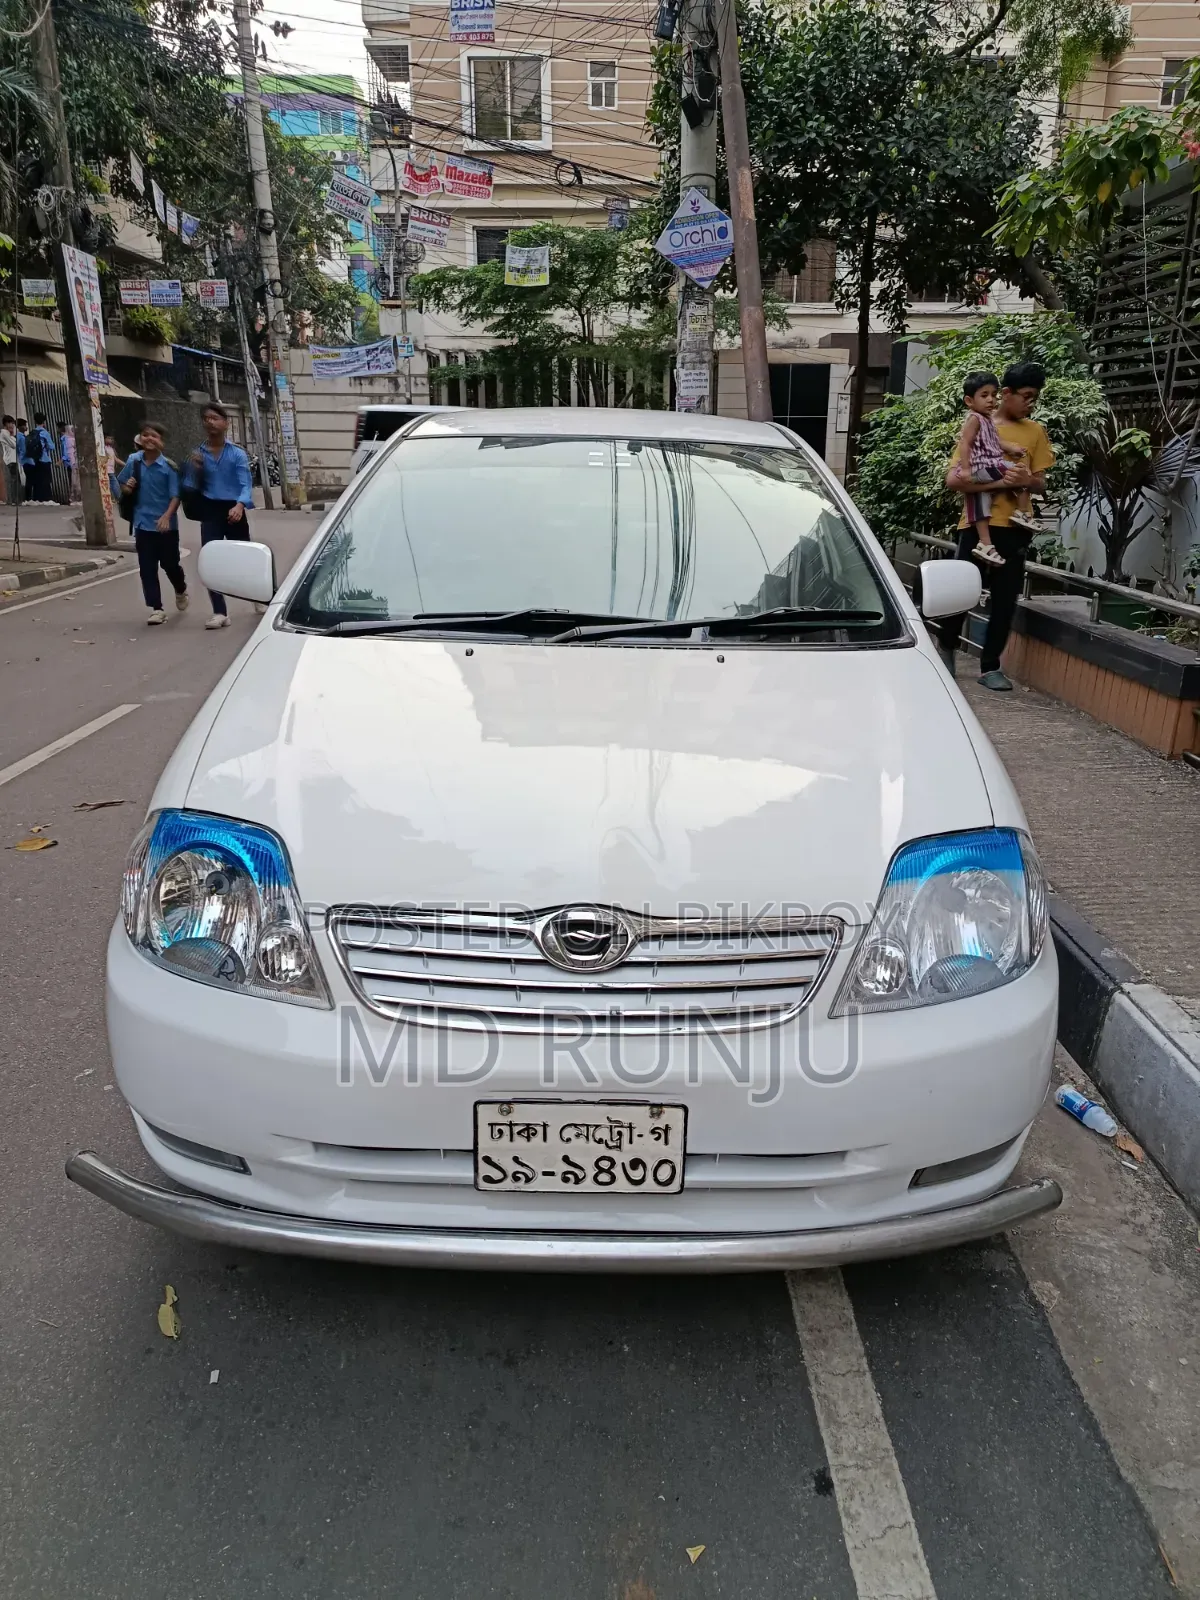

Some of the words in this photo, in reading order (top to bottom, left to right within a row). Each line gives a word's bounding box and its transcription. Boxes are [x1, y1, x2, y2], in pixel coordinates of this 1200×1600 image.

[451, 0, 493, 9] BRISK
[446, 164, 493, 187] Mazeda
[411, 207, 449, 226] BRISK
[670, 222, 728, 248] Orchid
[120, 281, 148, 290] BRISK
[488, 1120, 549, 1143] ঢাকা
[481, 1154, 677, 1187] ১৯-৯৪৩০
